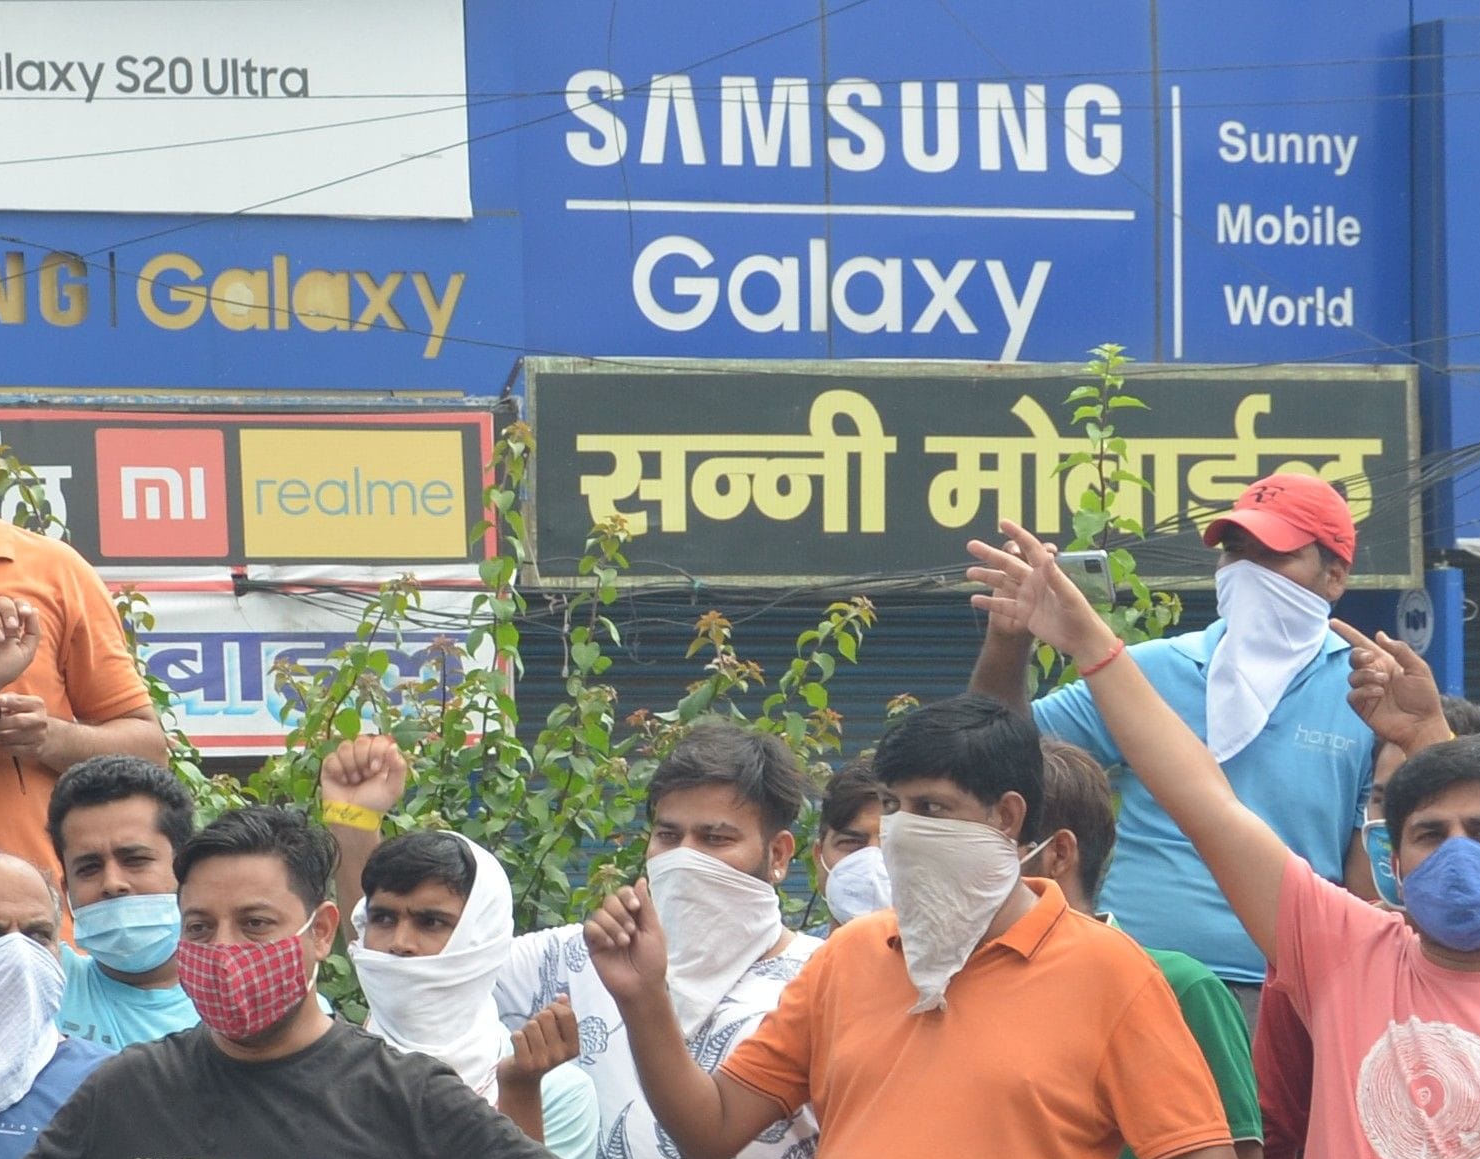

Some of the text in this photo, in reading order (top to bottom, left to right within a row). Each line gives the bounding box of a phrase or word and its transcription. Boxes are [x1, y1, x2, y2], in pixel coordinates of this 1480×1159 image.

[115, 55, 195, 96] S20
[202, 57, 309, 100] Ultra
[564, 69, 1122, 176] SAMSUNG
[1218, 120, 1359, 176] Sunny
[1216, 204, 1361, 247] Mobile
[136, 253, 465, 359] Galaxy
[631, 234, 1053, 363] Galaxy
[1223, 285, 1355, 328] World
[255, 465, 455, 517] realme
[577, 389, 897, 539] सन्नी
[1294, 724, 1357, 752] honor
